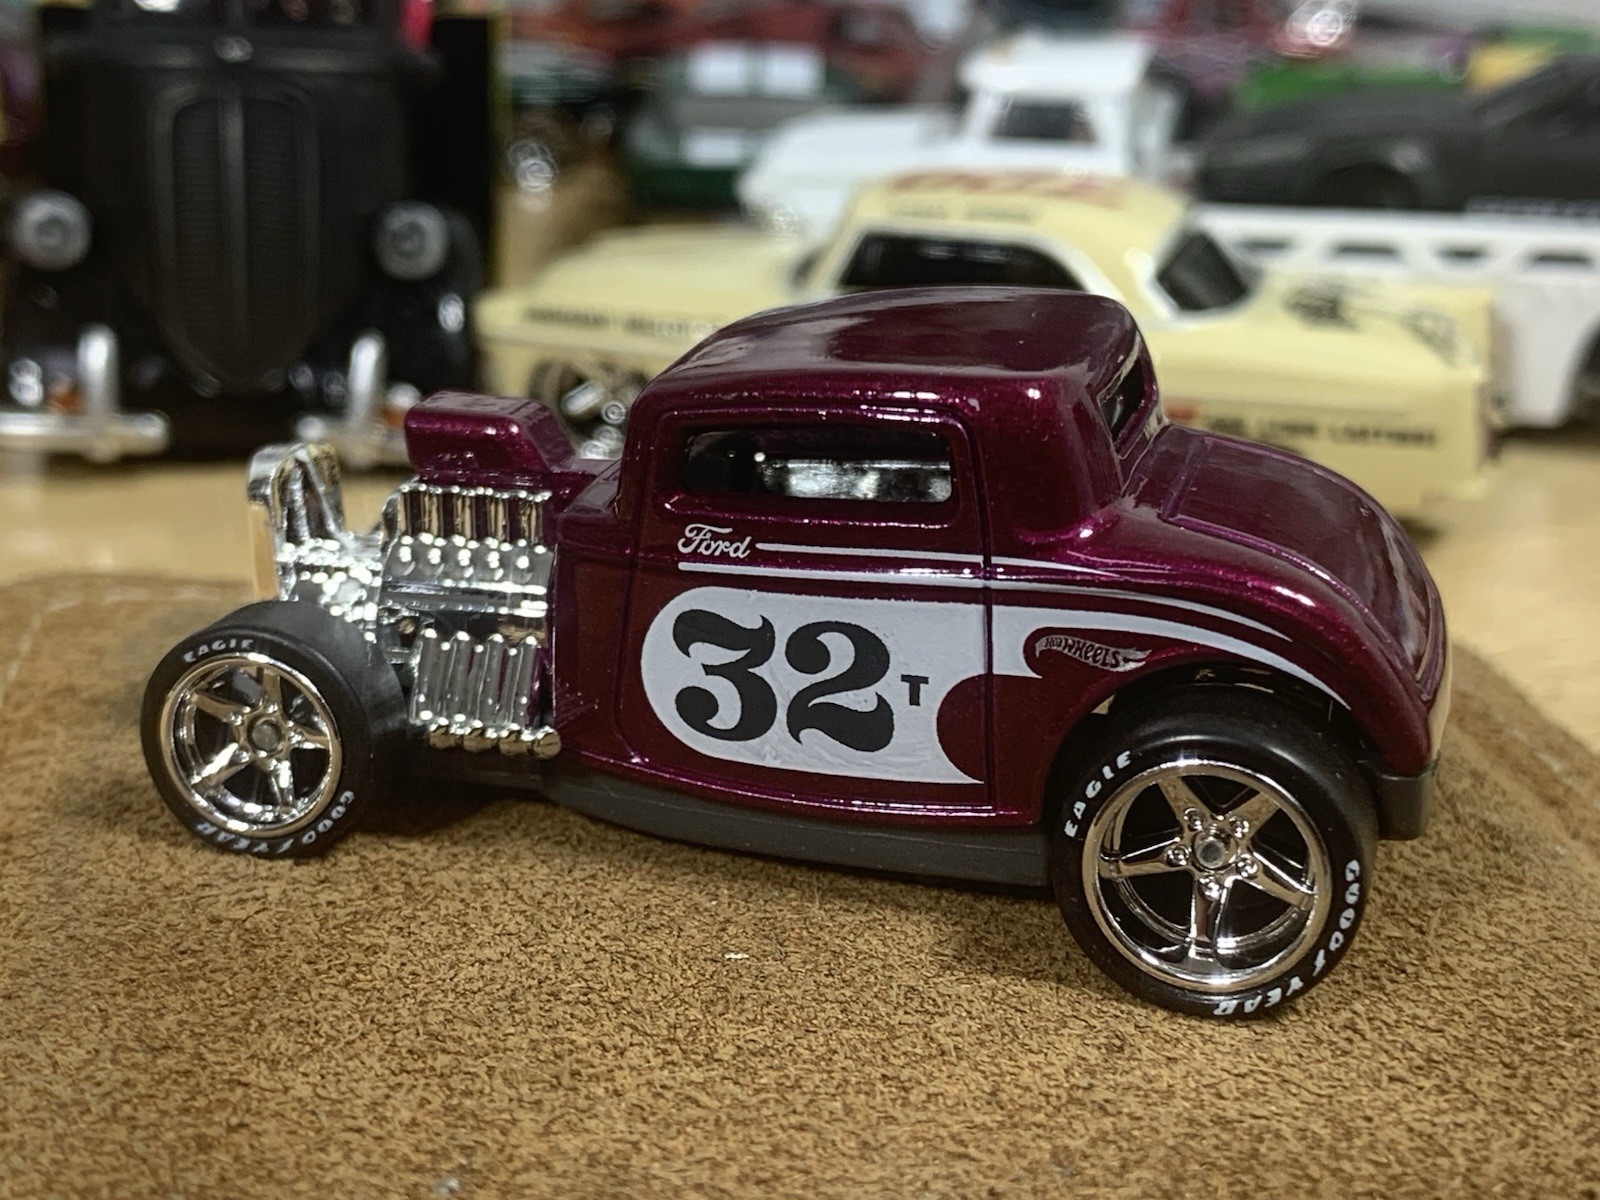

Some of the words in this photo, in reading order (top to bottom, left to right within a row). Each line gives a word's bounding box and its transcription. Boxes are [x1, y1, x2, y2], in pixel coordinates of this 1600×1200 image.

[677, 523, 752, 559] Ford
[672, 608, 895, 753] 32
[900, 674, 929, 706] T
[1063, 750, 1131, 838] EAGLE
